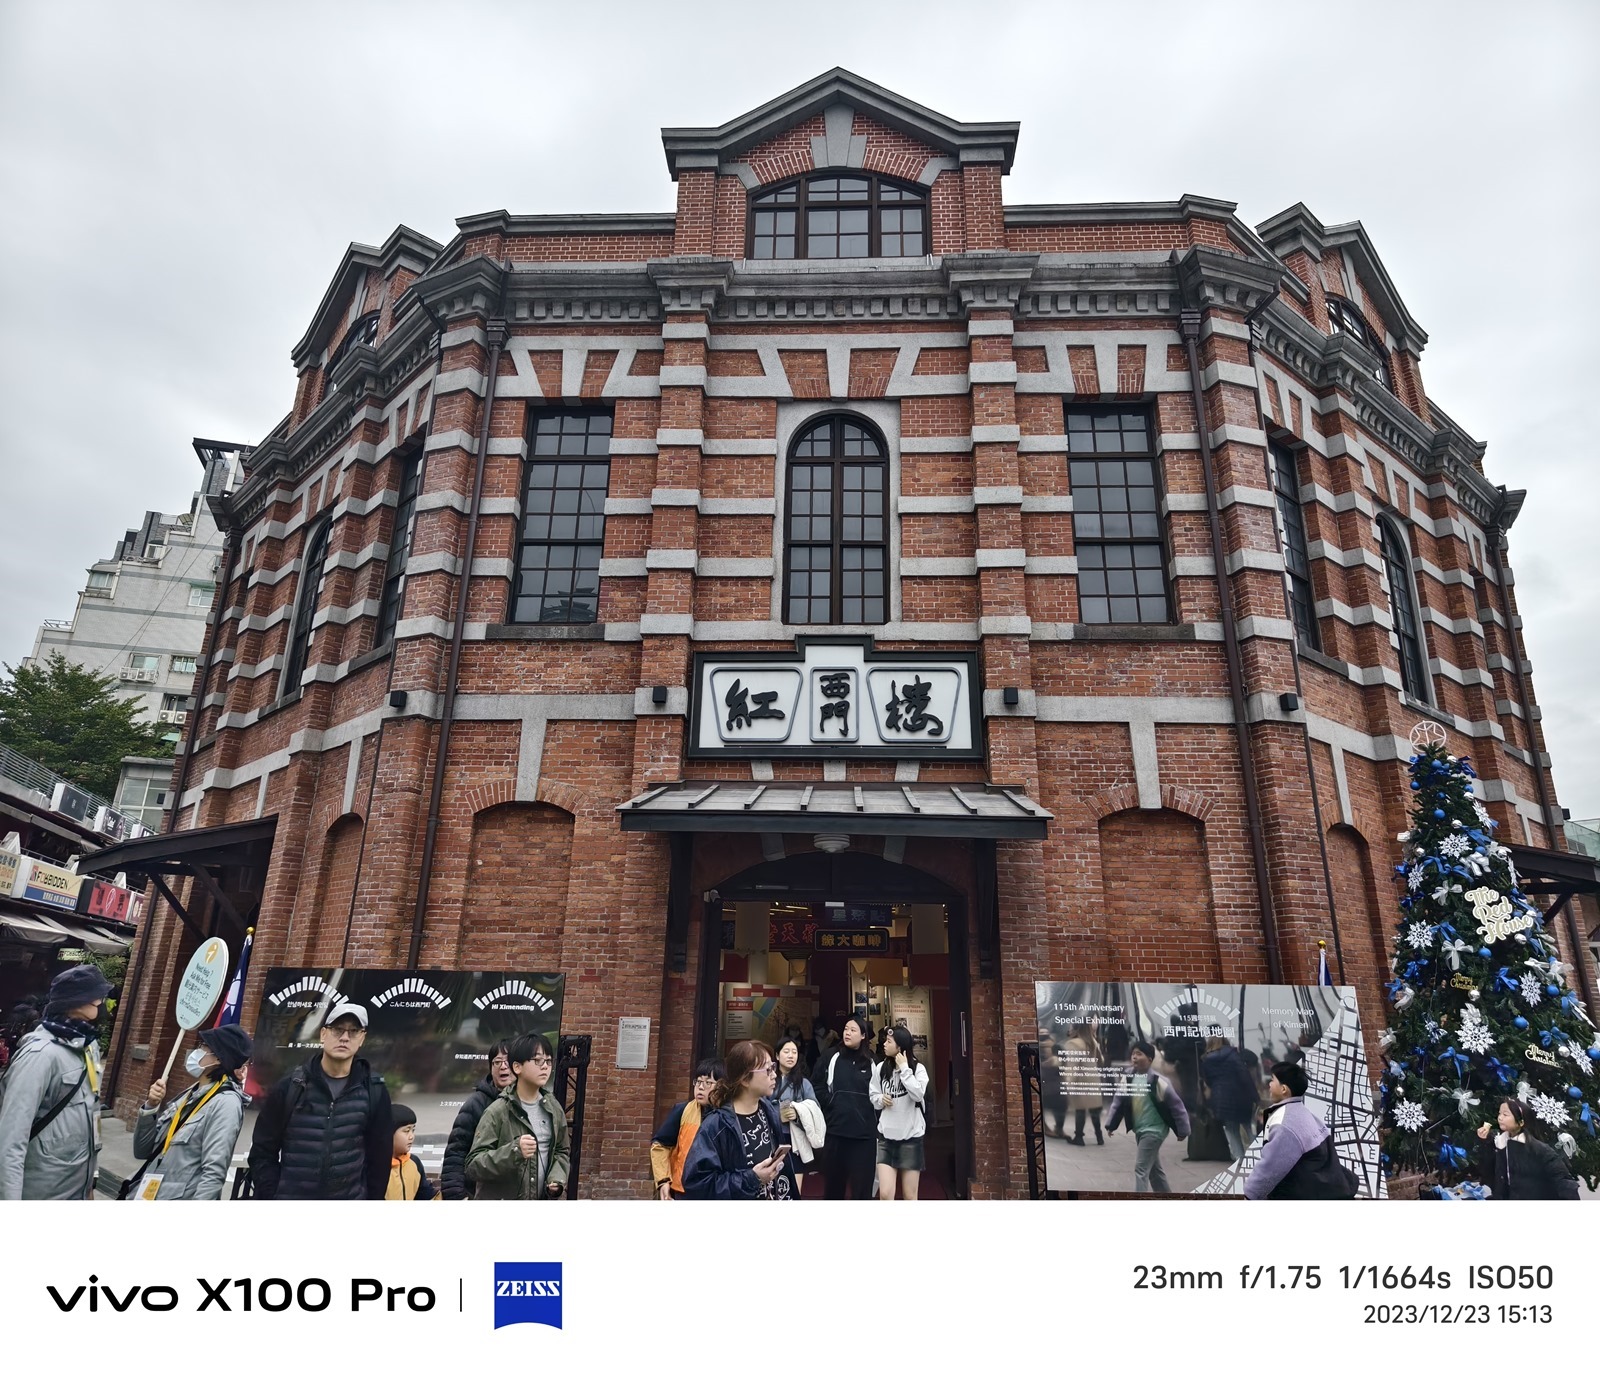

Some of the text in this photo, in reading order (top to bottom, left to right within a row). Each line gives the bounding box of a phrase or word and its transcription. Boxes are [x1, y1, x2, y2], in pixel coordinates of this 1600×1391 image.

[725, 678, 785, 731] 紅
[819, 672, 851, 737] 西門
[1464, 886, 1499, 907] The
[1472, 895, 1512, 924] Red
[1476, 914, 1534, 944] House
[499, 1004, 535, 1012] Ximending
[1053, 1003, 1125, 1013] 115th Anniversary
[1261, 1007, 1315, 1017] Memory Map
[1055, 1016, 1125, 1025] Special Exhibition
[1273, 1020, 1309, 1029] of Ximen
[1164, 1026, 1235, 1038] 西門記憶地圖
